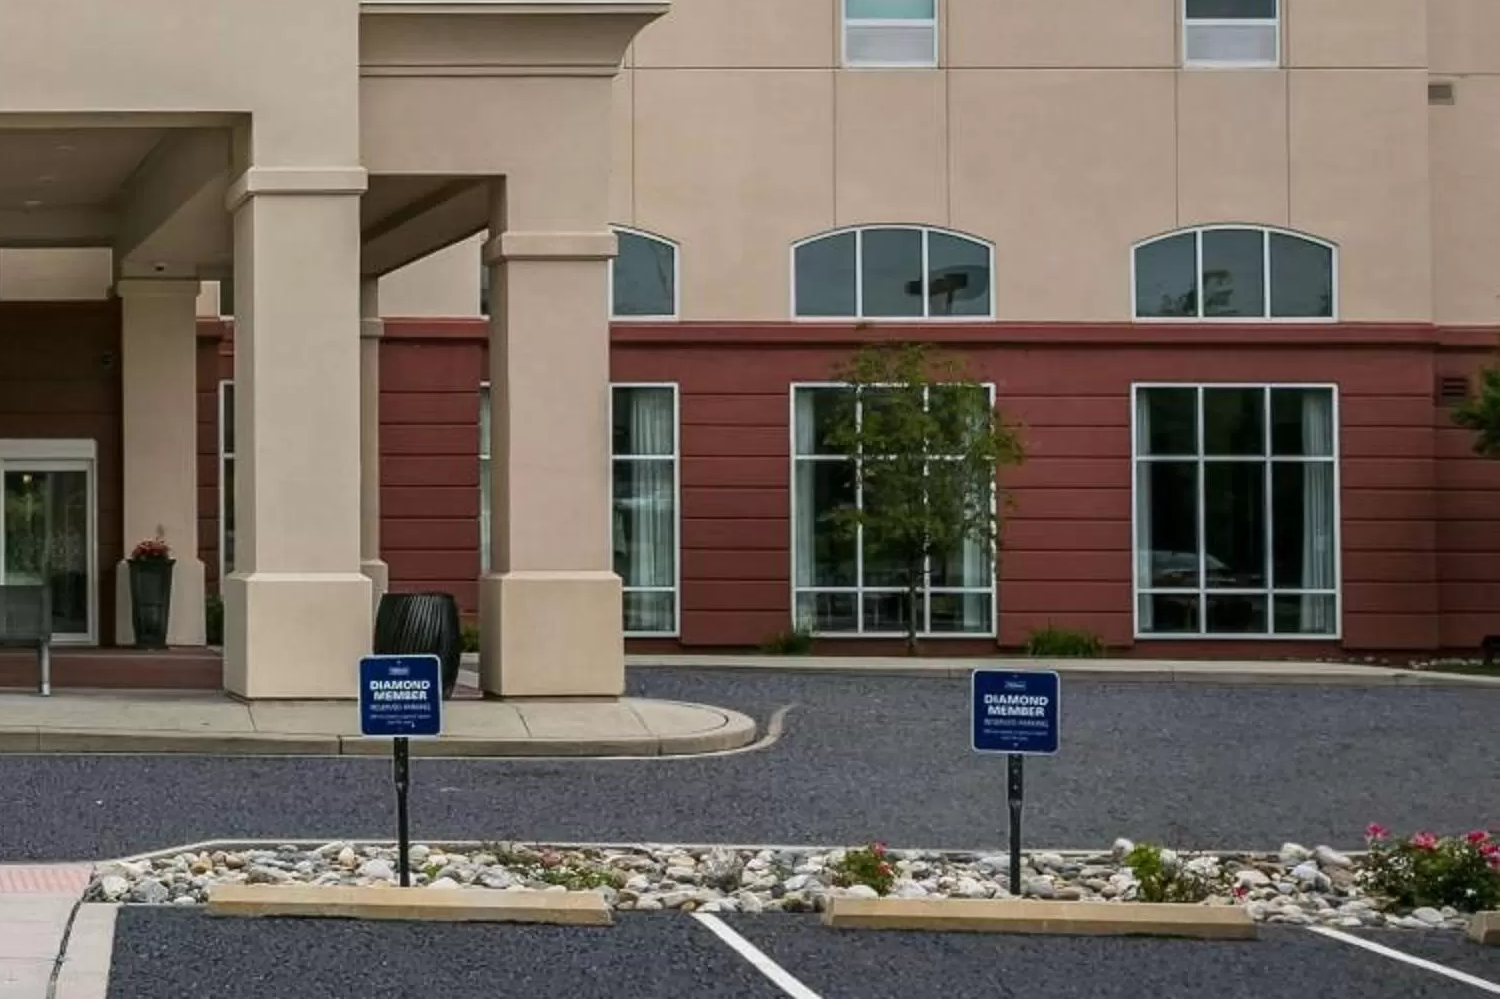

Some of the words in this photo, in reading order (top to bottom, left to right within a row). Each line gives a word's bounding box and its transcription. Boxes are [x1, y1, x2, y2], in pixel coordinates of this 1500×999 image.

[369, 680, 431, 691] DIAMOND
[373, 690, 428, 701] MEMBER
[983, 693, 1050, 706] DIAMOND
[987, 705, 1045, 717] MEMBER
